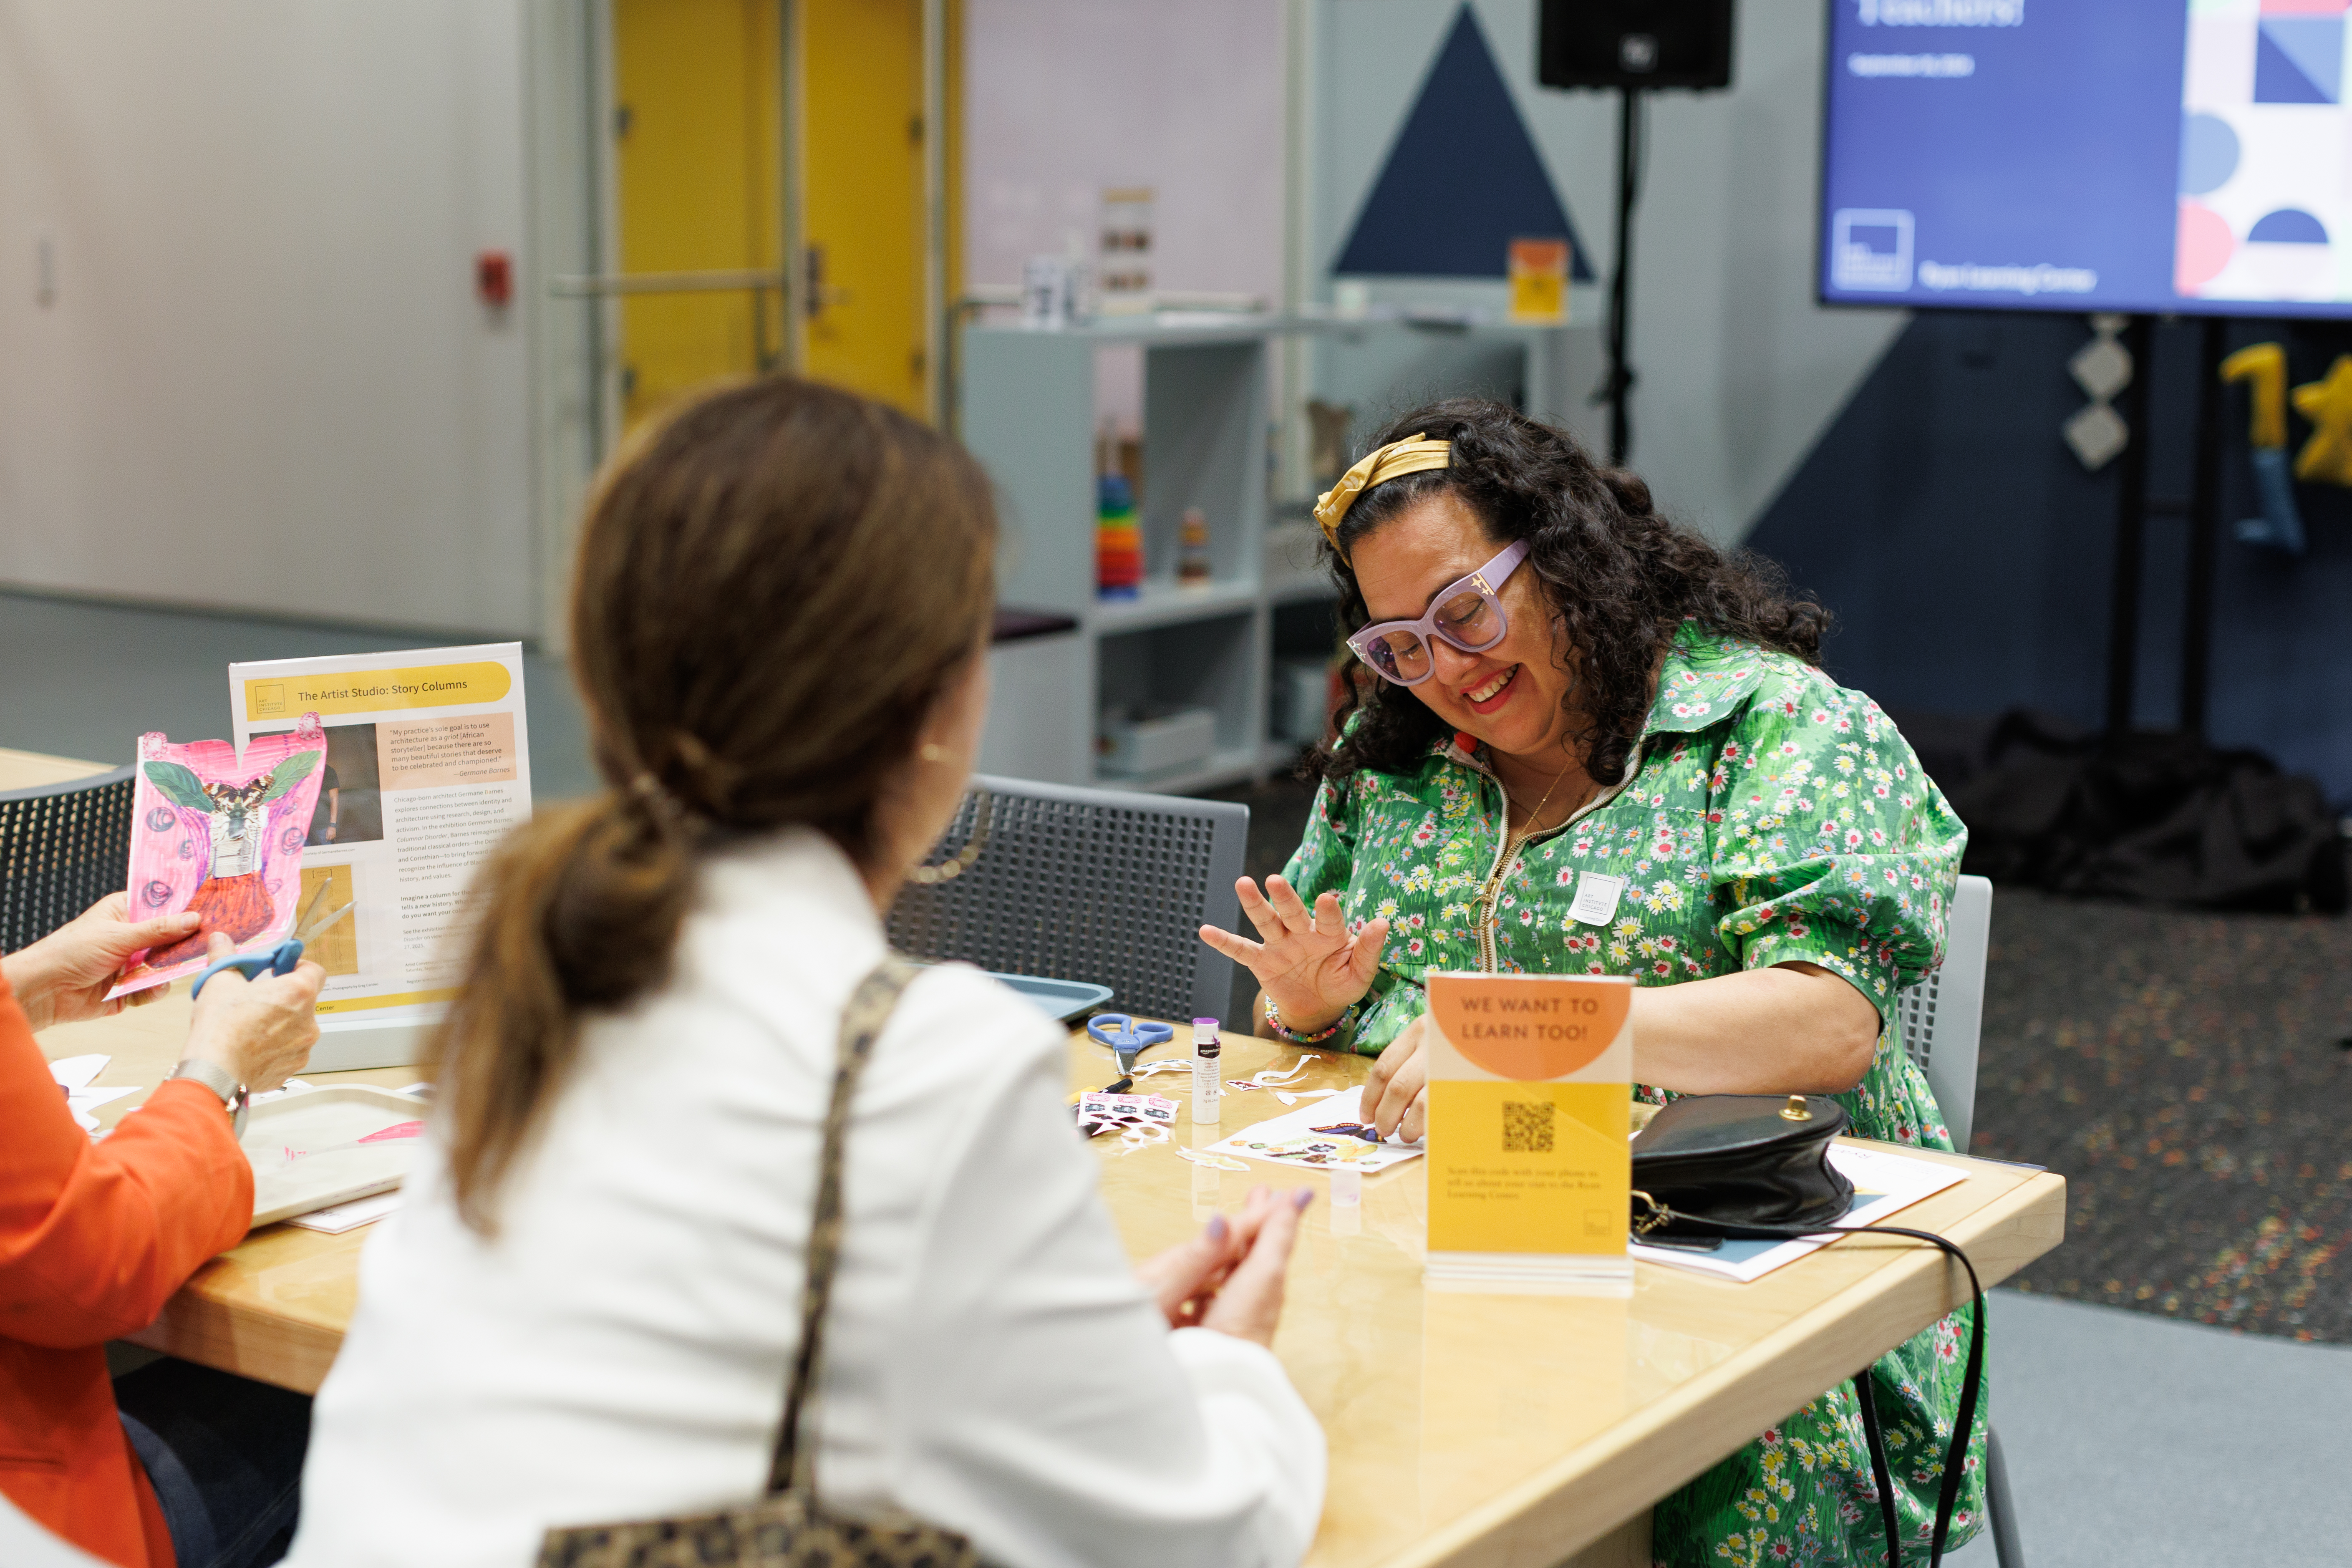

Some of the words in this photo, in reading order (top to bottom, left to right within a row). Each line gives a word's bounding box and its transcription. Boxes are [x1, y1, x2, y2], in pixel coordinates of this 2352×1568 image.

[298, 691, 318, 701] The
[321, 689, 348, 699] Artist
[352, 686, 388, 697] Studio:
[392, 685, 419, 694] Story
[422, 681, 467, 691] Columns
[391, 736, 429, 745] architecture
[444, 734, 459, 742] griot
[460, 732, 484, 740] [African
[391, 745, 426, 754] storyteller]
[410, 761, 443, 770] celebrated
[394, 795, 431, 804] Chicago-born
[1462, 997, 1491, 1013] WE
[1499, 997, 1560, 1013] WANT
[1571, 998, 1598, 1014] TO
[1462, 1023, 1528, 1039] LEARN
[1535, 1024, 1587, 1041] TOO!
